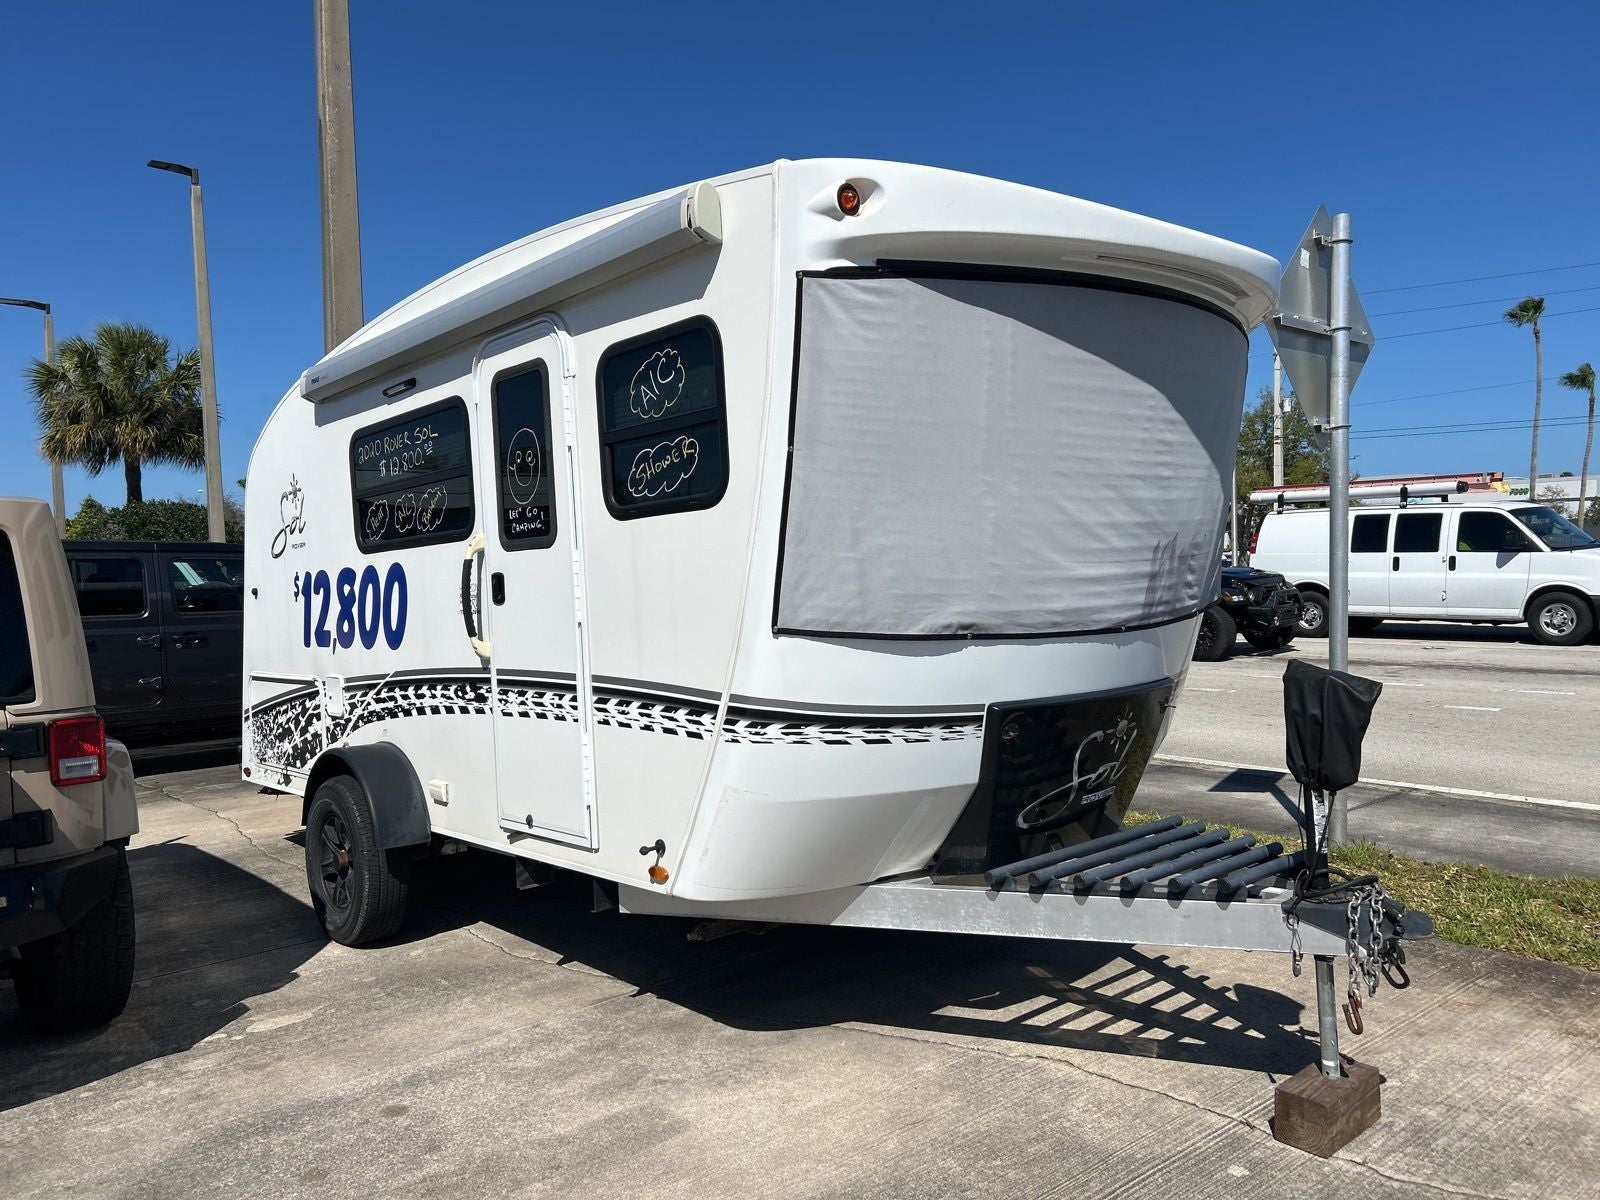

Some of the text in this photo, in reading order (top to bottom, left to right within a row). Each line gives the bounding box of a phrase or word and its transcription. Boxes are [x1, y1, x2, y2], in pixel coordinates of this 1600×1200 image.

[641, 357, 675, 410] A/C
[358, 425, 439, 464] 2020 ROVER SOL
[635, 440, 695, 491] SHOWER
[526, 506, 538, 517] GO
[293, 562, 408, 656] $12,800
